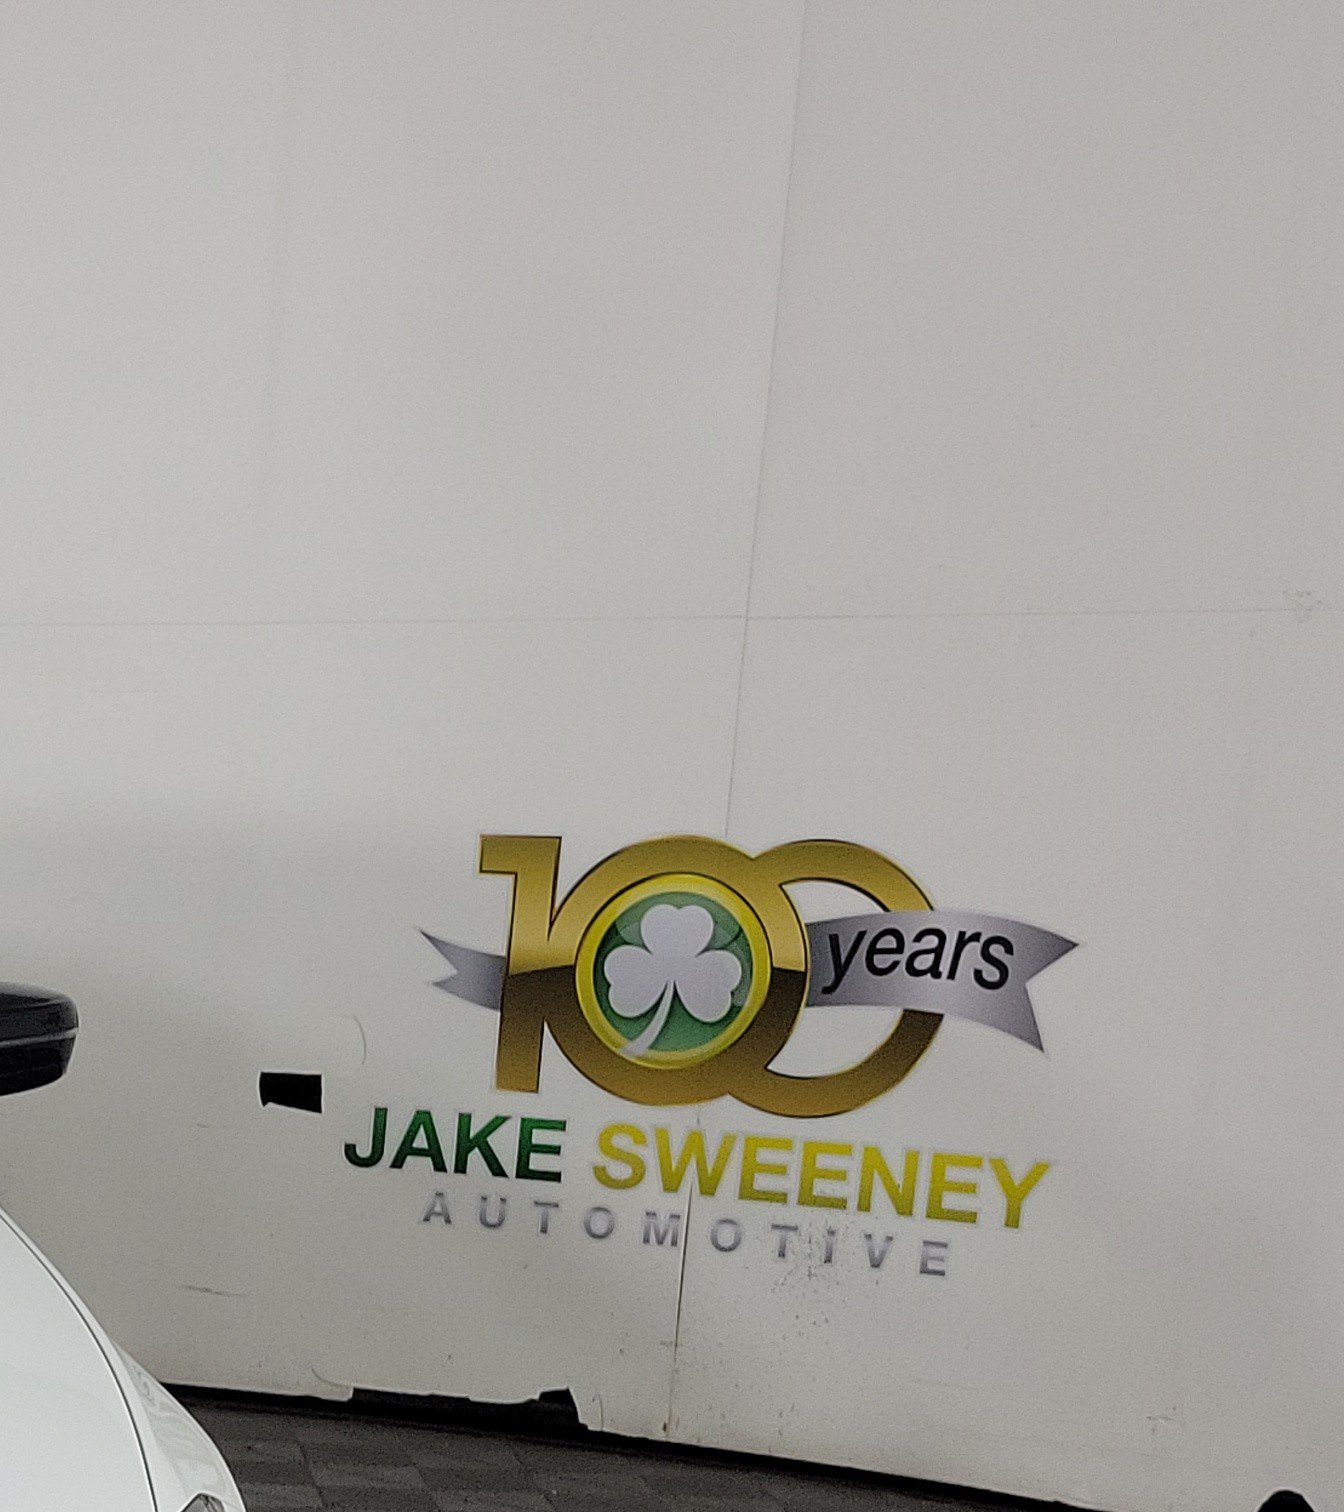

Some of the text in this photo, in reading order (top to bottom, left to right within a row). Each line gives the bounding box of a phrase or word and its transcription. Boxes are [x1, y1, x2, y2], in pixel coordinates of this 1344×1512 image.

[478, 834, 1013, 1119] 100 years
[343, 1107, 1050, 1229] JAKE SWEENEY
[421, 1191, 950, 1277] AUTOMOTIVE
